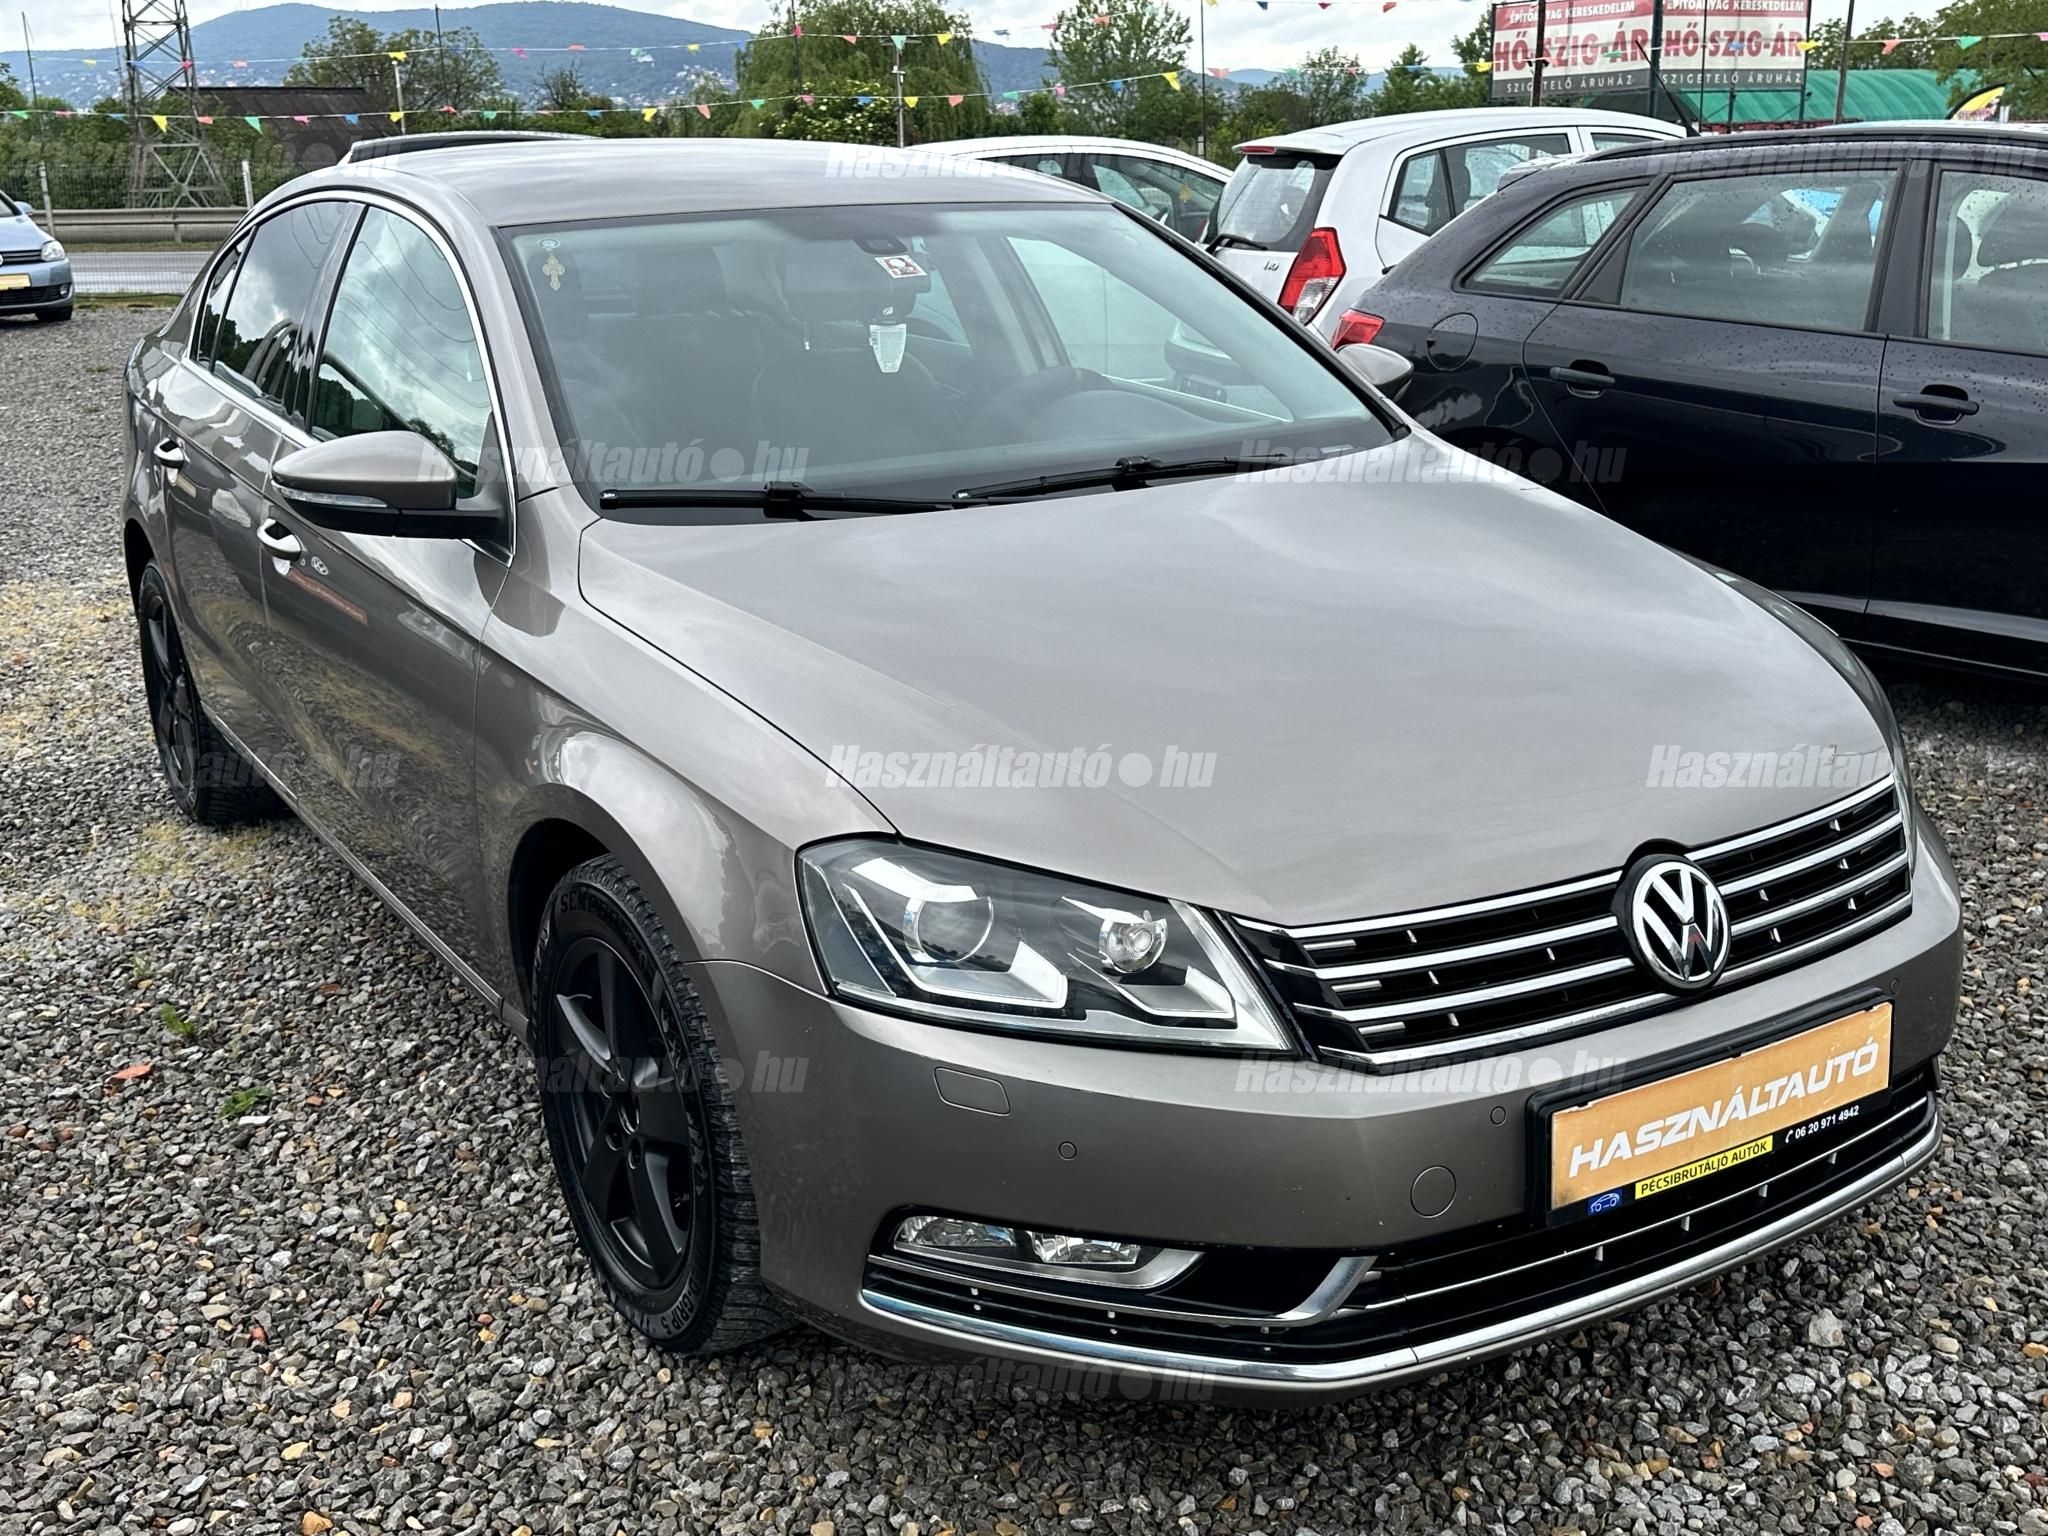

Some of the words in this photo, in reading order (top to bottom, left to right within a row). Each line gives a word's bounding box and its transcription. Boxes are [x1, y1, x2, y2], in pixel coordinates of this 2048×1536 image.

[1565, 1, 1636, 19] KERESKEDELEM
[1507, 77, 1572, 94] SZIGTELŐ
[1580, 74, 1634, 90] ÁRUHÁZ
[1661, 71, 1739, 85] SZIGETELŐ
[1747, 71, 1802, 85] ÁRUHÁZ
[1568, 1038, 1879, 1179] HASZNÁLTAUTÓ
[1795, 1126, 1806, 1140] 06
[1807, 1121, 1819, 1135] 20
[1820, 1113, 1836, 1129] 971
[1838, 1104, 1860, 1121] 4942
